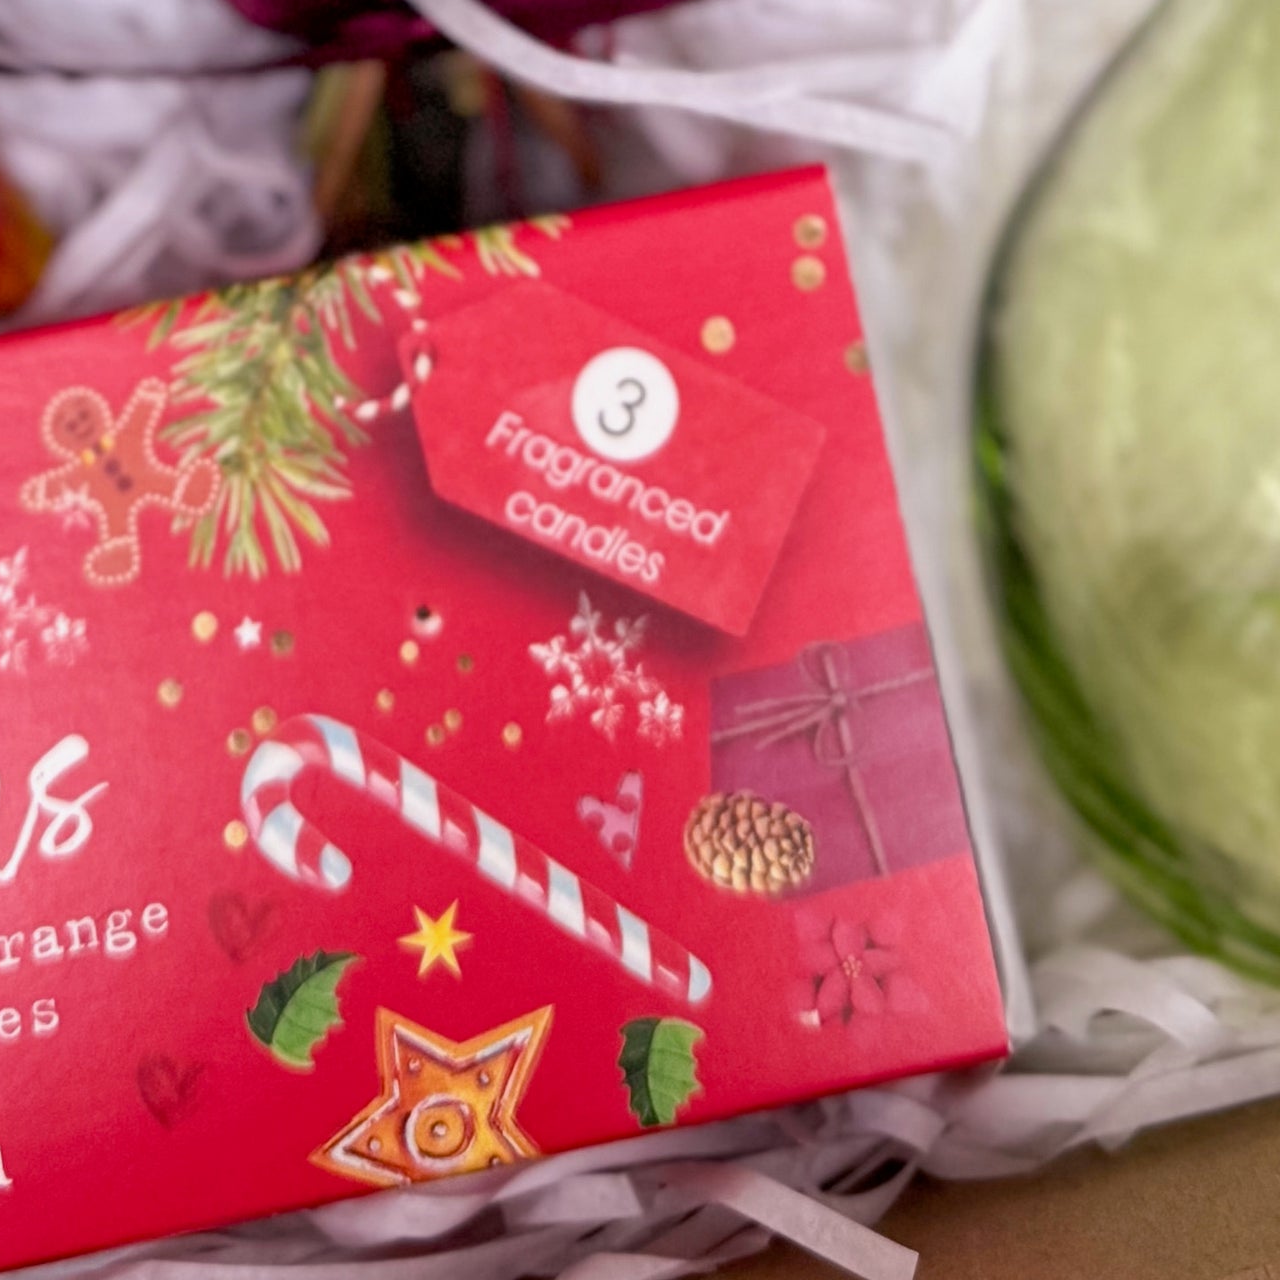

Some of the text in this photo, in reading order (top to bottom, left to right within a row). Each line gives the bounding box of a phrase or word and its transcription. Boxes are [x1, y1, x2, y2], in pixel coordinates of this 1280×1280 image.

[597, 377, 647, 438] 3
[485, 409, 730, 546] Fragranced
[505, 489, 666, 583] candles
